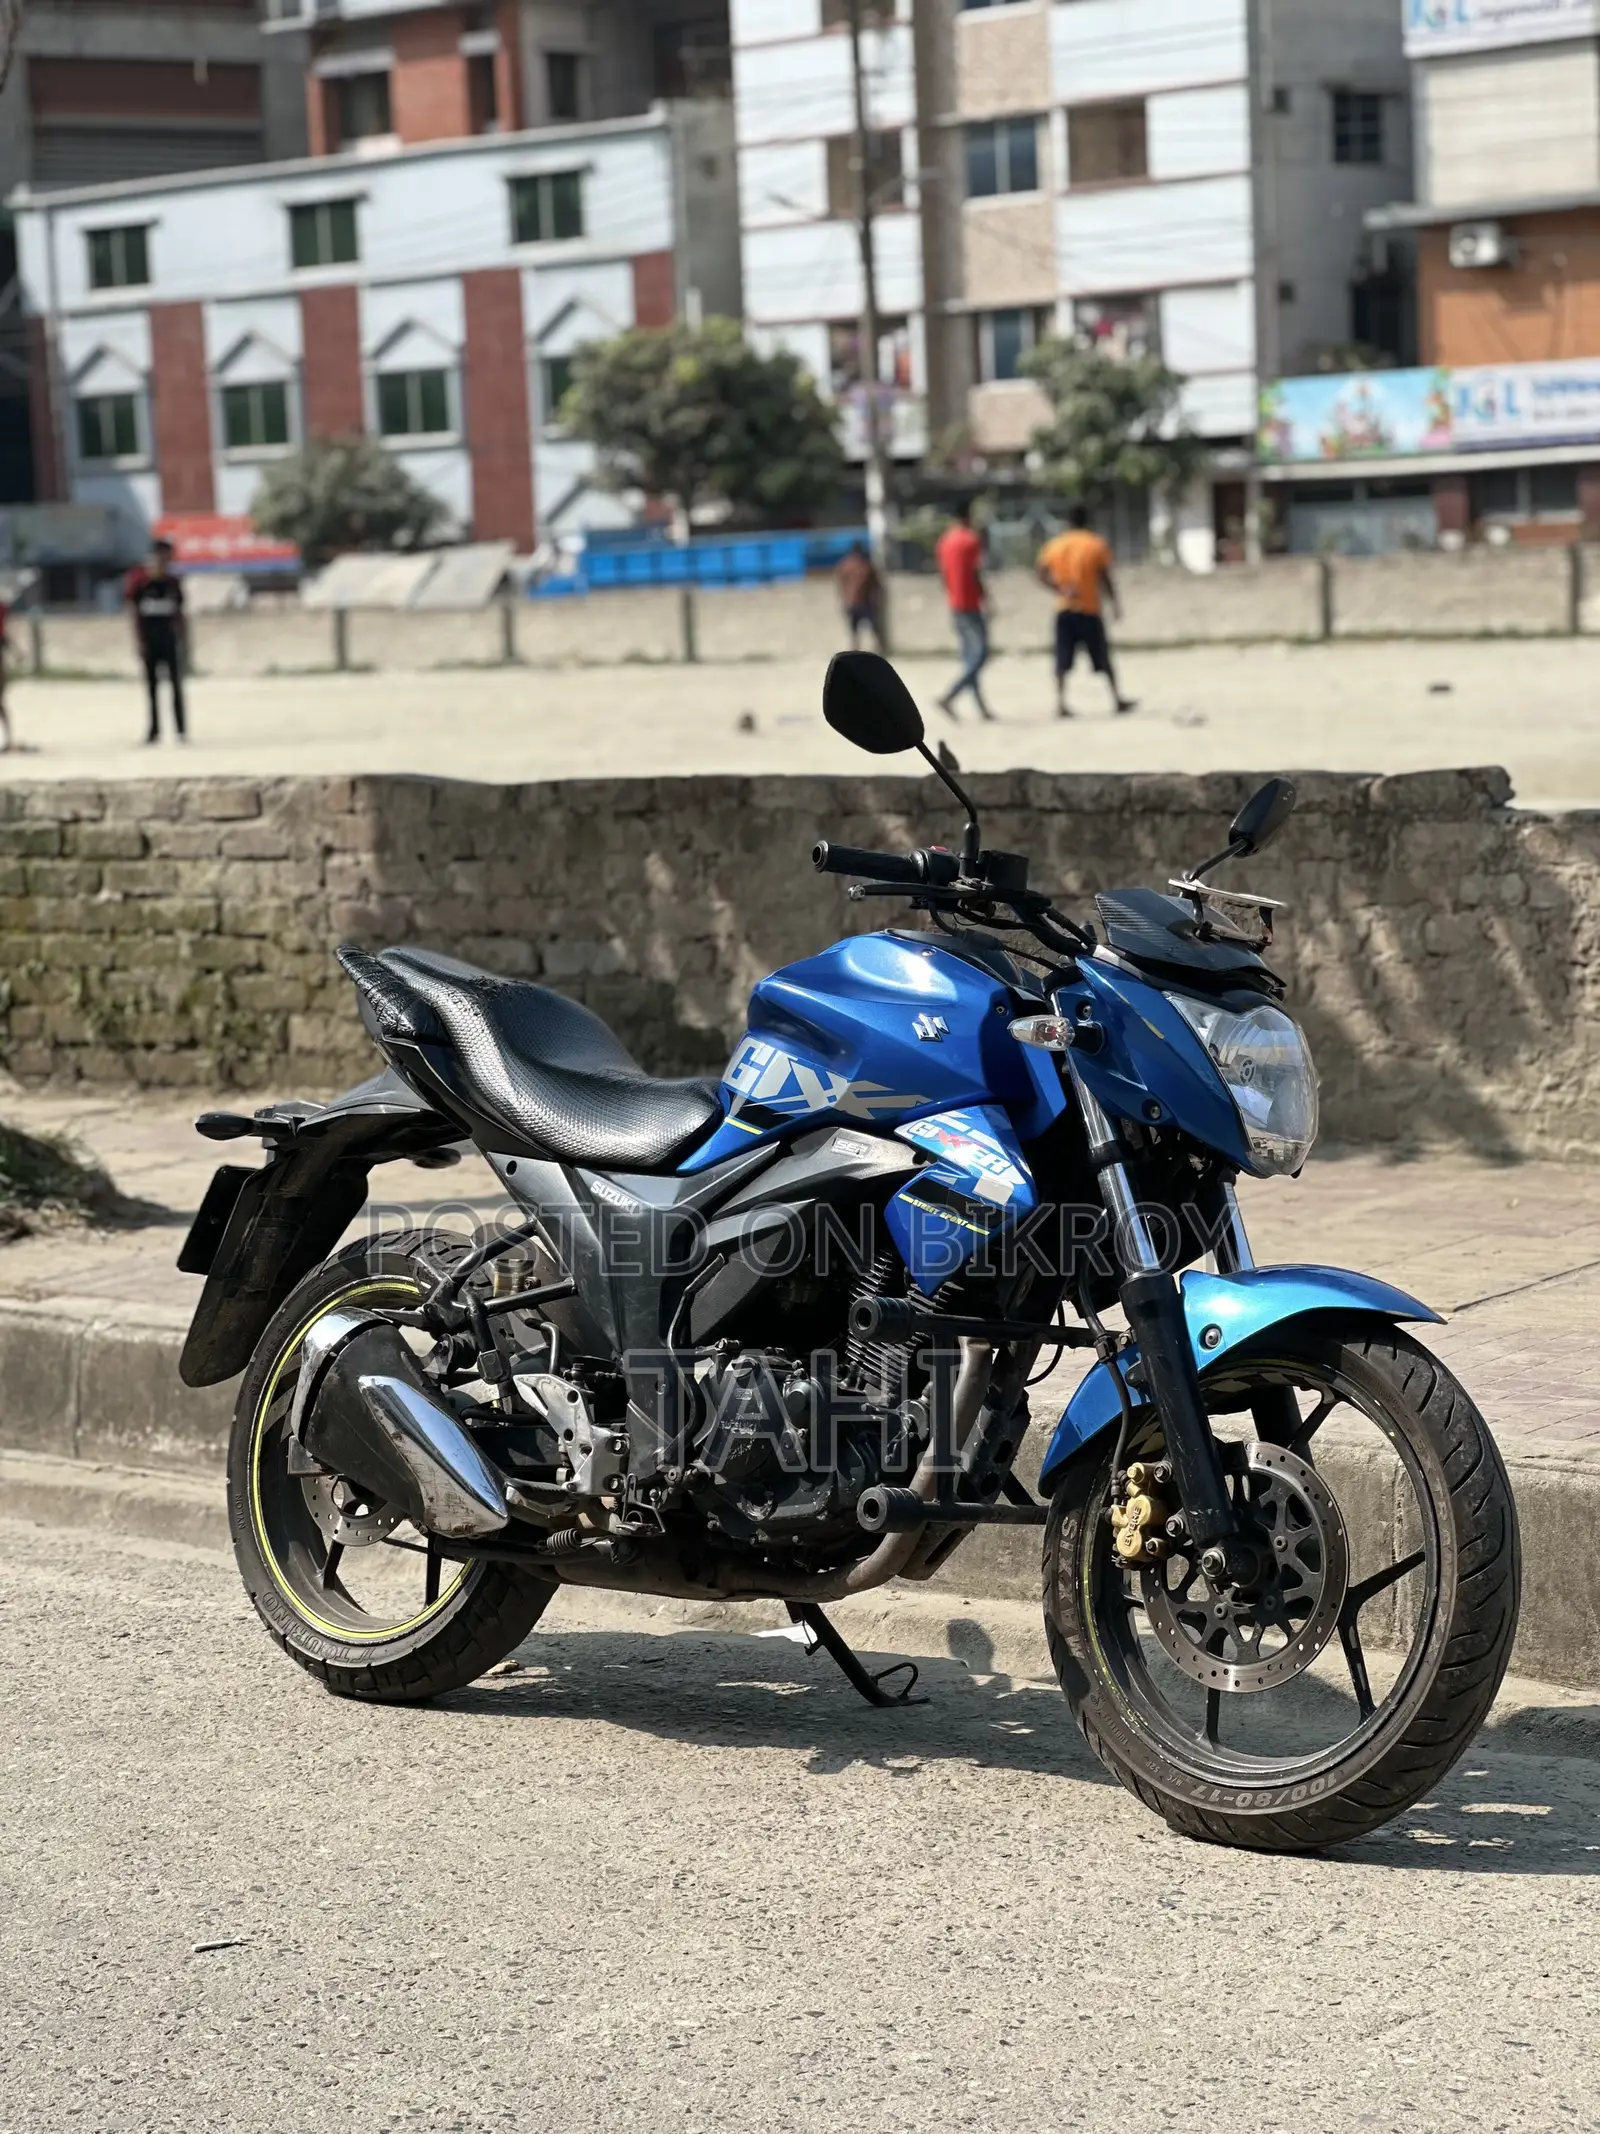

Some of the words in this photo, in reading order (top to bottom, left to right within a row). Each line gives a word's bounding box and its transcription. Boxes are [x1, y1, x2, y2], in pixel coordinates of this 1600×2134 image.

[590, 1180, 639, 1214] SUZUKI
[912, 1199, 940, 1215] STREET
[939, 1211, 969, 1227] SPORT
[1190, 1772, 1337, 1808] 100/80-17
